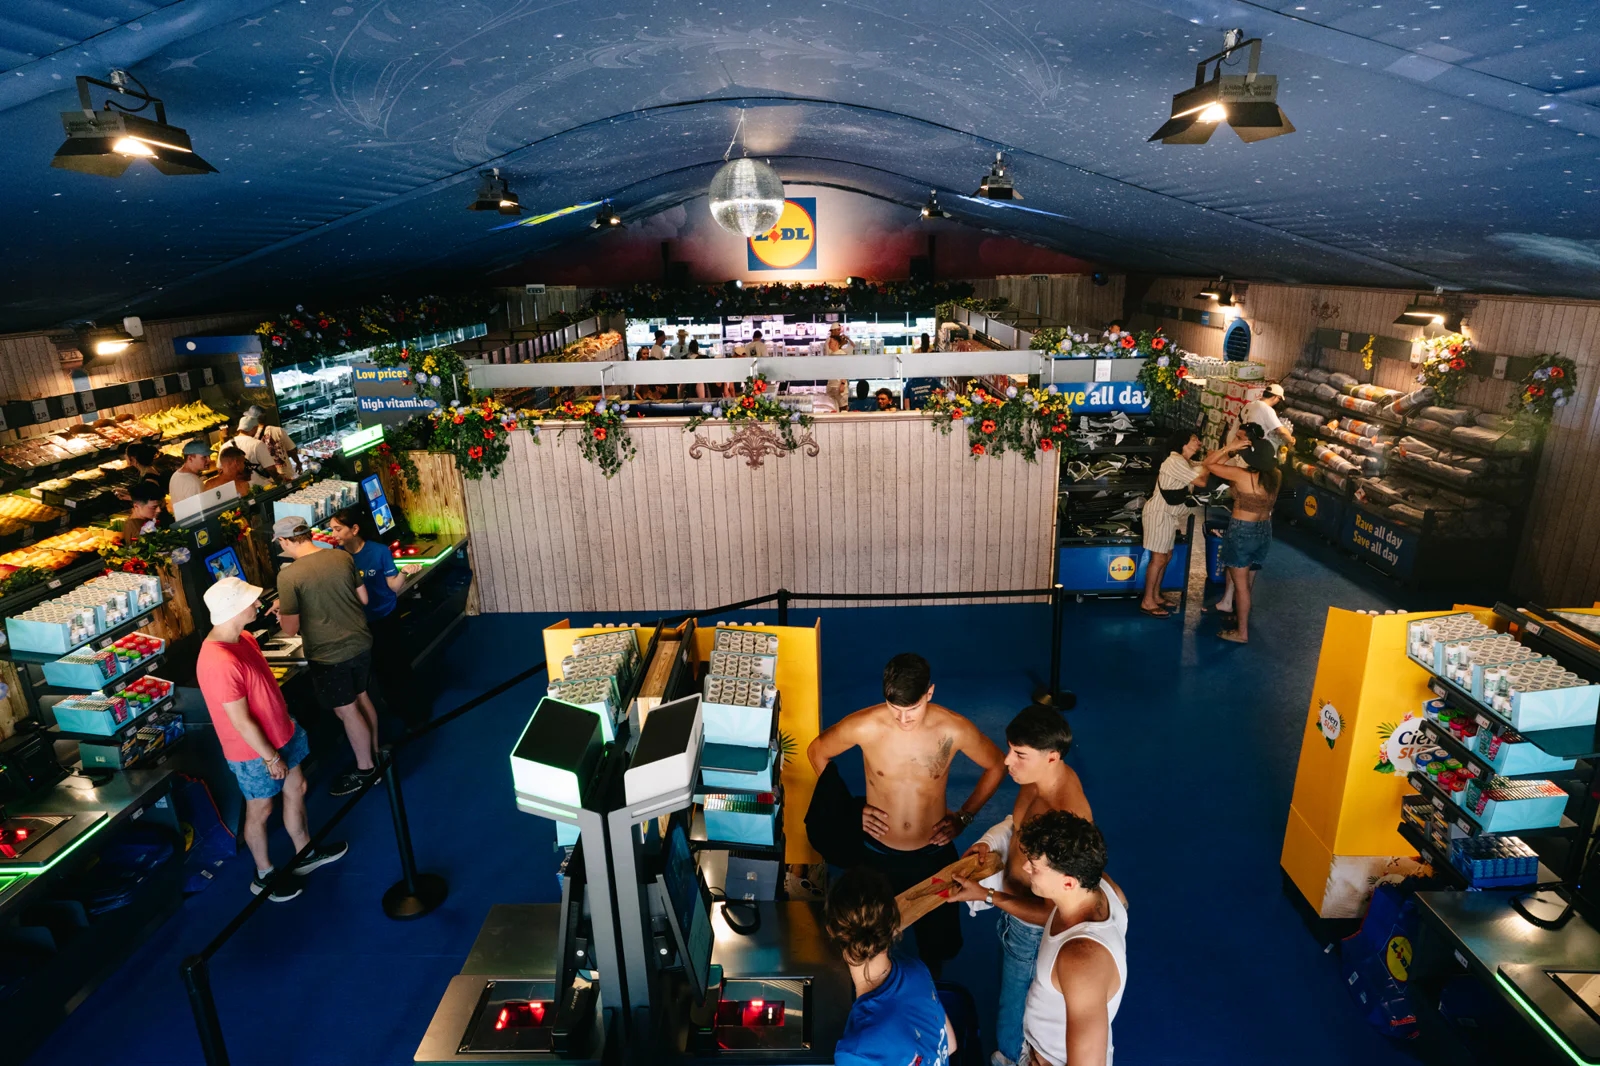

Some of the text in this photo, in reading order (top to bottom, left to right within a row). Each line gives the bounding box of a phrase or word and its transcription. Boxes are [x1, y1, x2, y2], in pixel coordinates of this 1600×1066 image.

[356, 368, 407, 381] Low prices
[361, 398, 385, 411] high
[1090, 386, 1114, 405] all
[1119, 386, 1151, 409] day
[216, 490, 221, 500] 9
[1355, 514, 1402, 549] Rave all day
[1353, 530, 1398, 565] Save all day
[1324, 710, 1338, 727] Cien
